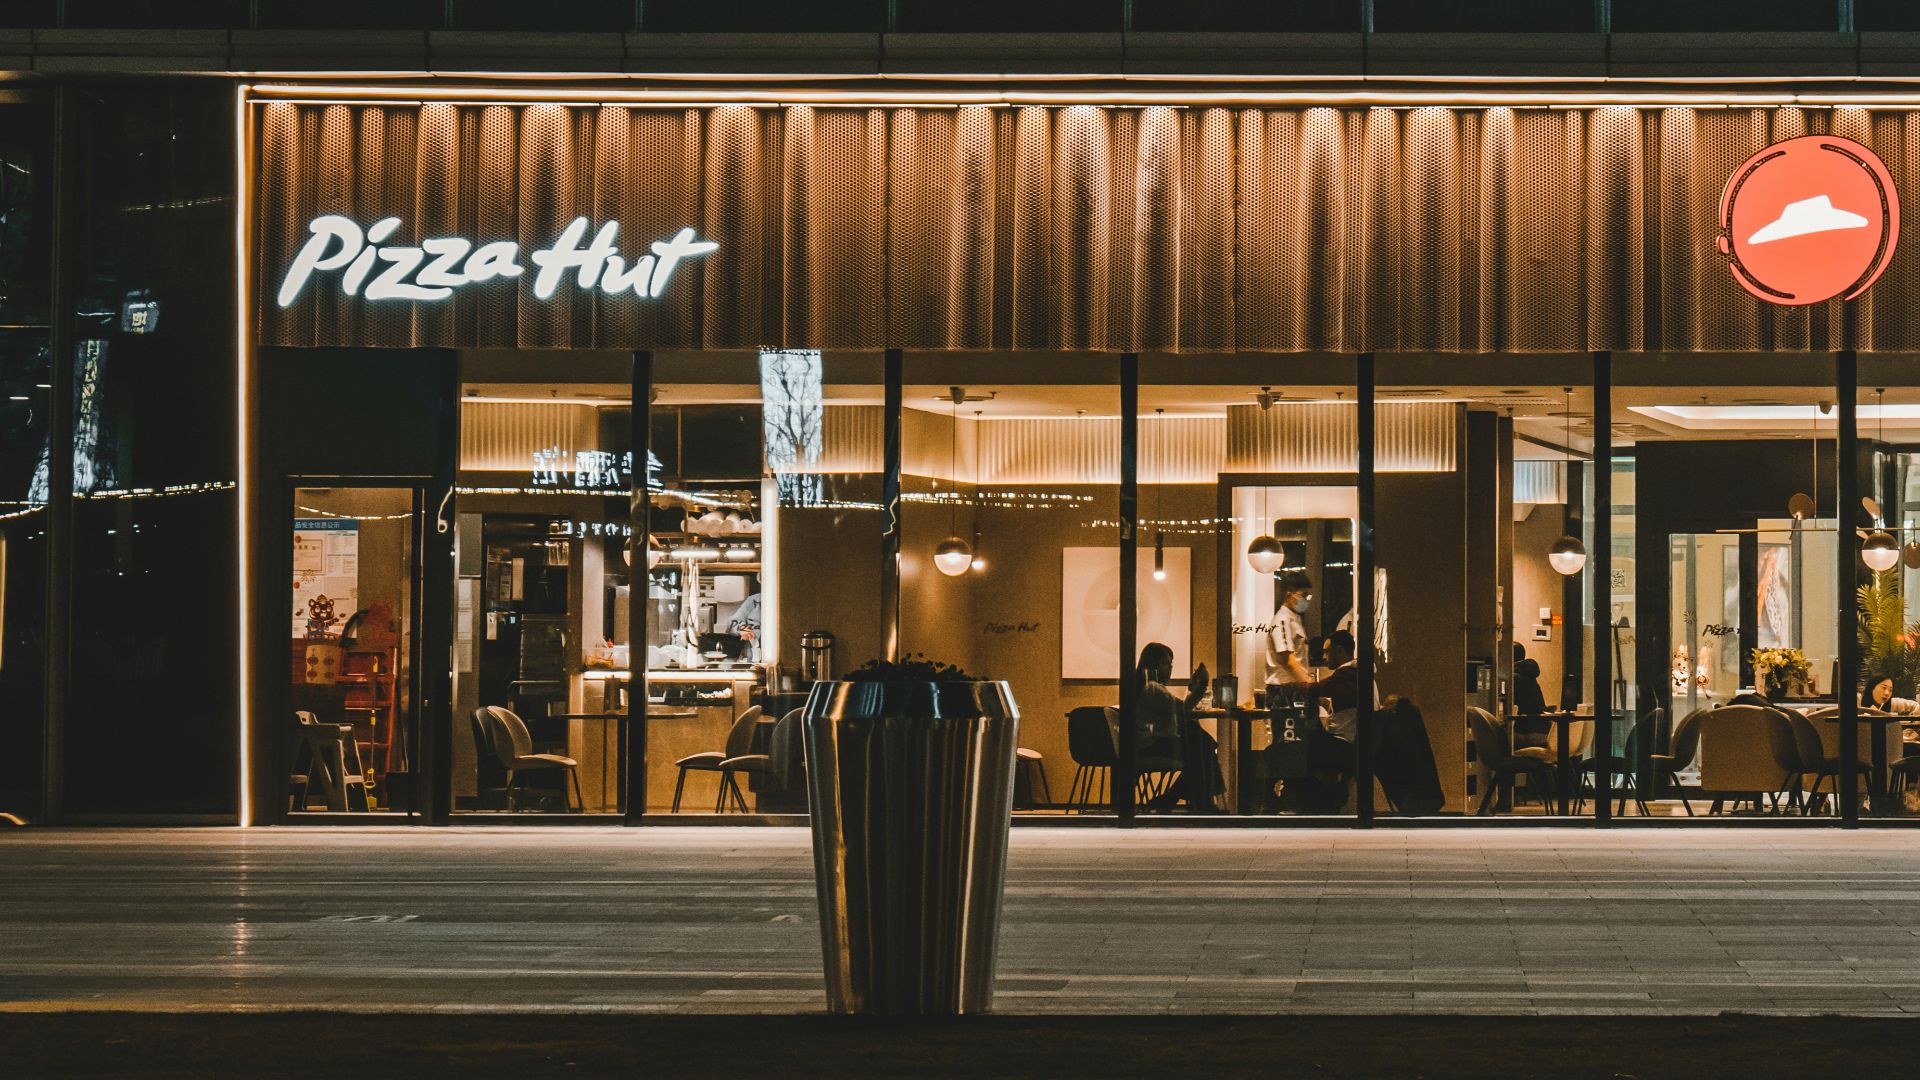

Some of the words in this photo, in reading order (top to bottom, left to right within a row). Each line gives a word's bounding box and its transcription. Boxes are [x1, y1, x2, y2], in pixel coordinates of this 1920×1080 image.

[278, 215, 524, 307] Pizza
[531, 216, 719, 299] Hut
[1231, 623, 1253, 635] izza
[1253, 623, 1280, 634] Hut
[1702, 623, 1735, 637] Pizza
